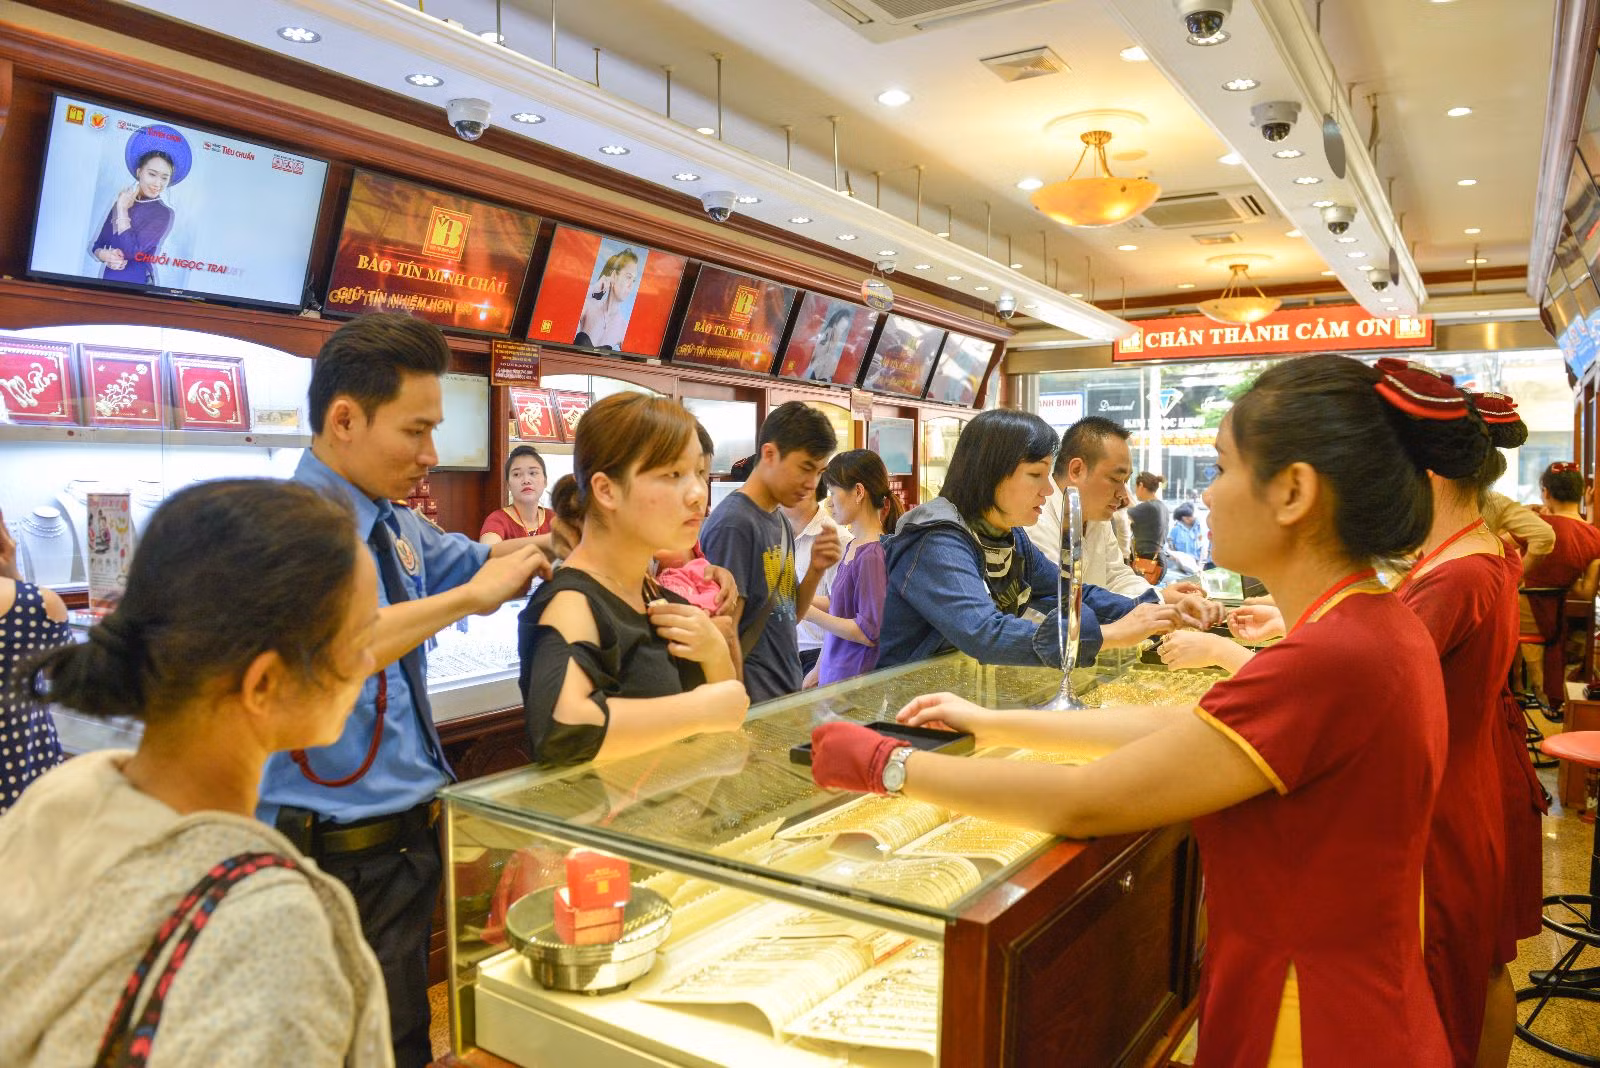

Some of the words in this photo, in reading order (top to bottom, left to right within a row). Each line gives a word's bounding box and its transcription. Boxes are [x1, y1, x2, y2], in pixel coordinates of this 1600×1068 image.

[135, 251, 169, 266] CHUỖI
[172, 258, 204, 271] NGỌC
[356, 253, 392, 273] BẢO
[397, 260, 423, 279] TÍN
[427, 268, 467, 287] MINH
[468, 276, 508, 294] CHÂU
[693, 319, 712, 334] BẢO
[1145, 326, 1204, 348] CHÂN
[1209, 322, 1290, 345] THÀNH
[1296, 318, 1350, 339] CẢM
[1356, 317, 1392, 337] ƠN
